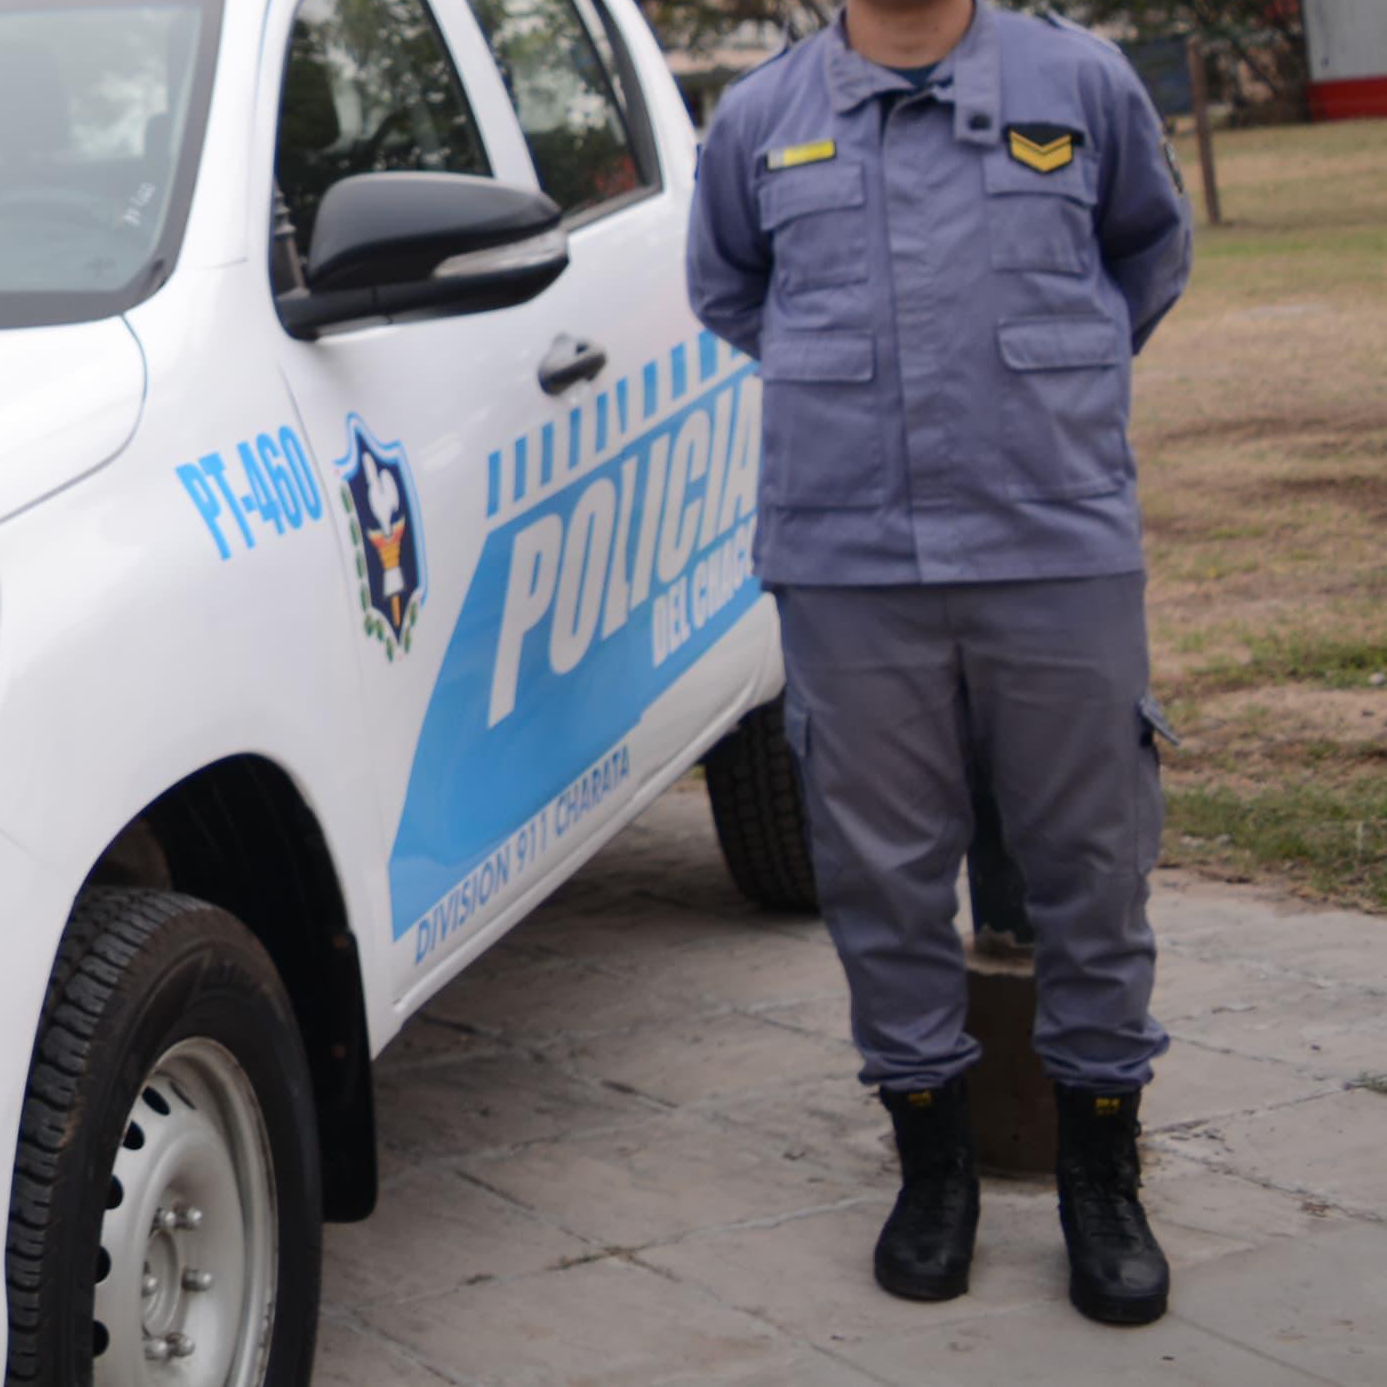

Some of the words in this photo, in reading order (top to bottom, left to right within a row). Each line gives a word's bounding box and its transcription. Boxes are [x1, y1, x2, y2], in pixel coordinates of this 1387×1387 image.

[174, 424, 323, 561] PT-460
[486, 375, 764, 730] POLICIA
[653, 575, 691, 669] DEL
[414, 844, 511, 967] DIVISION
[516, 811, 549, 874] 911
[554, 744, 631, 838] CHARATA
